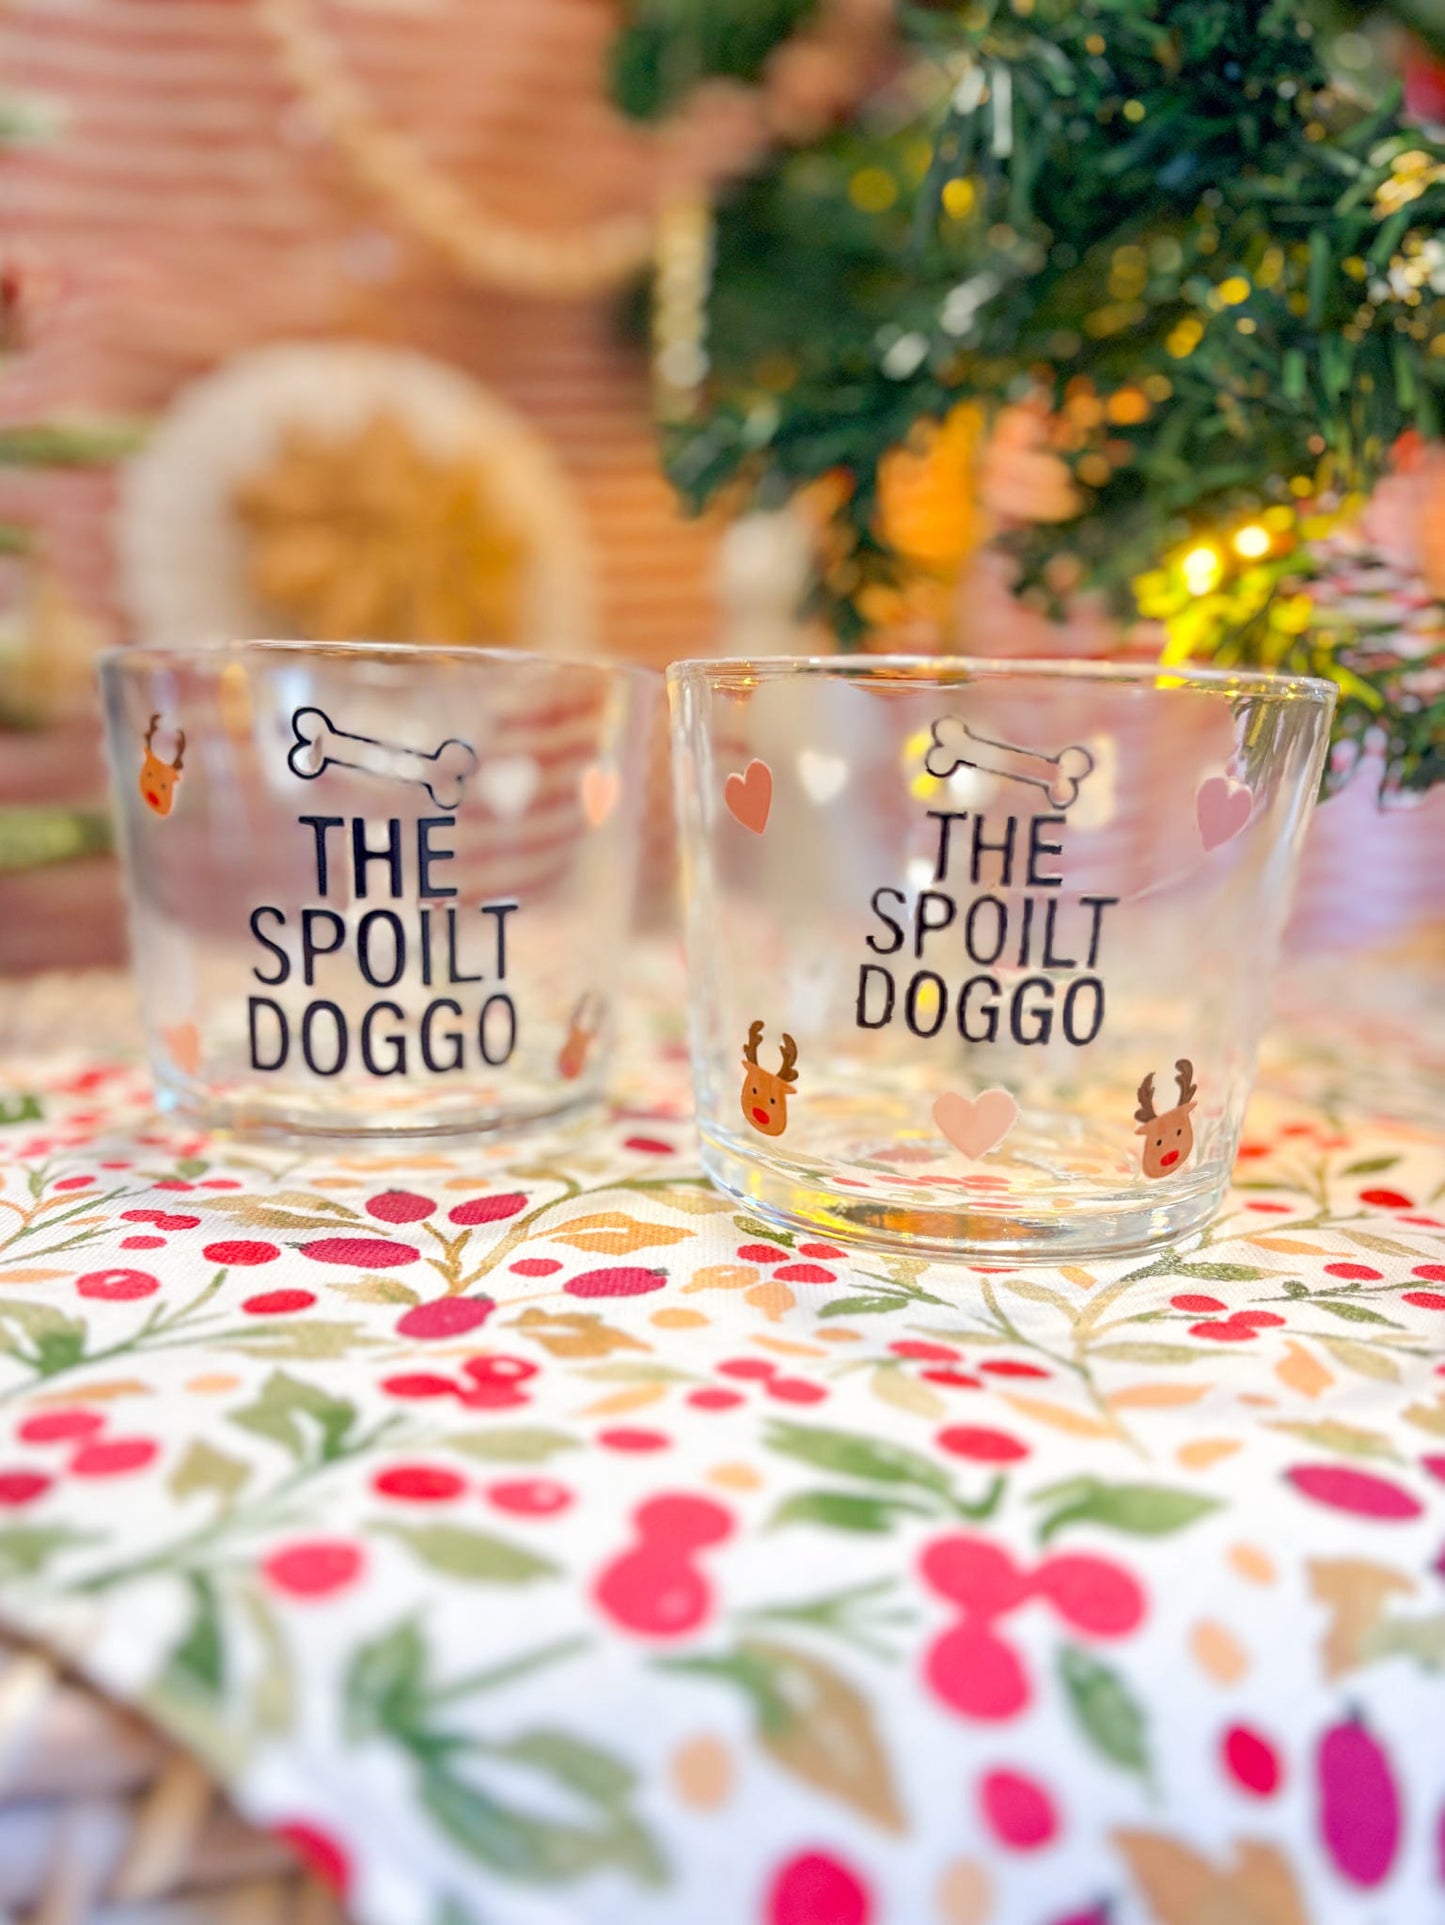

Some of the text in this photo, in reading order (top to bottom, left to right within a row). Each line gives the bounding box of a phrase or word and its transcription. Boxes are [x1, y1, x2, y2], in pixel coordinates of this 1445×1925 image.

[297, 815, 460, 900] THE
[925, 809, 1068, 888] THE
[248, 903, 520, 988] SPOILT
[865, 887, 1121, 970] SPOILT
[247, 994, 518, 1078] DOGGO
[856, 964, 1105, 1048] DOGGO
